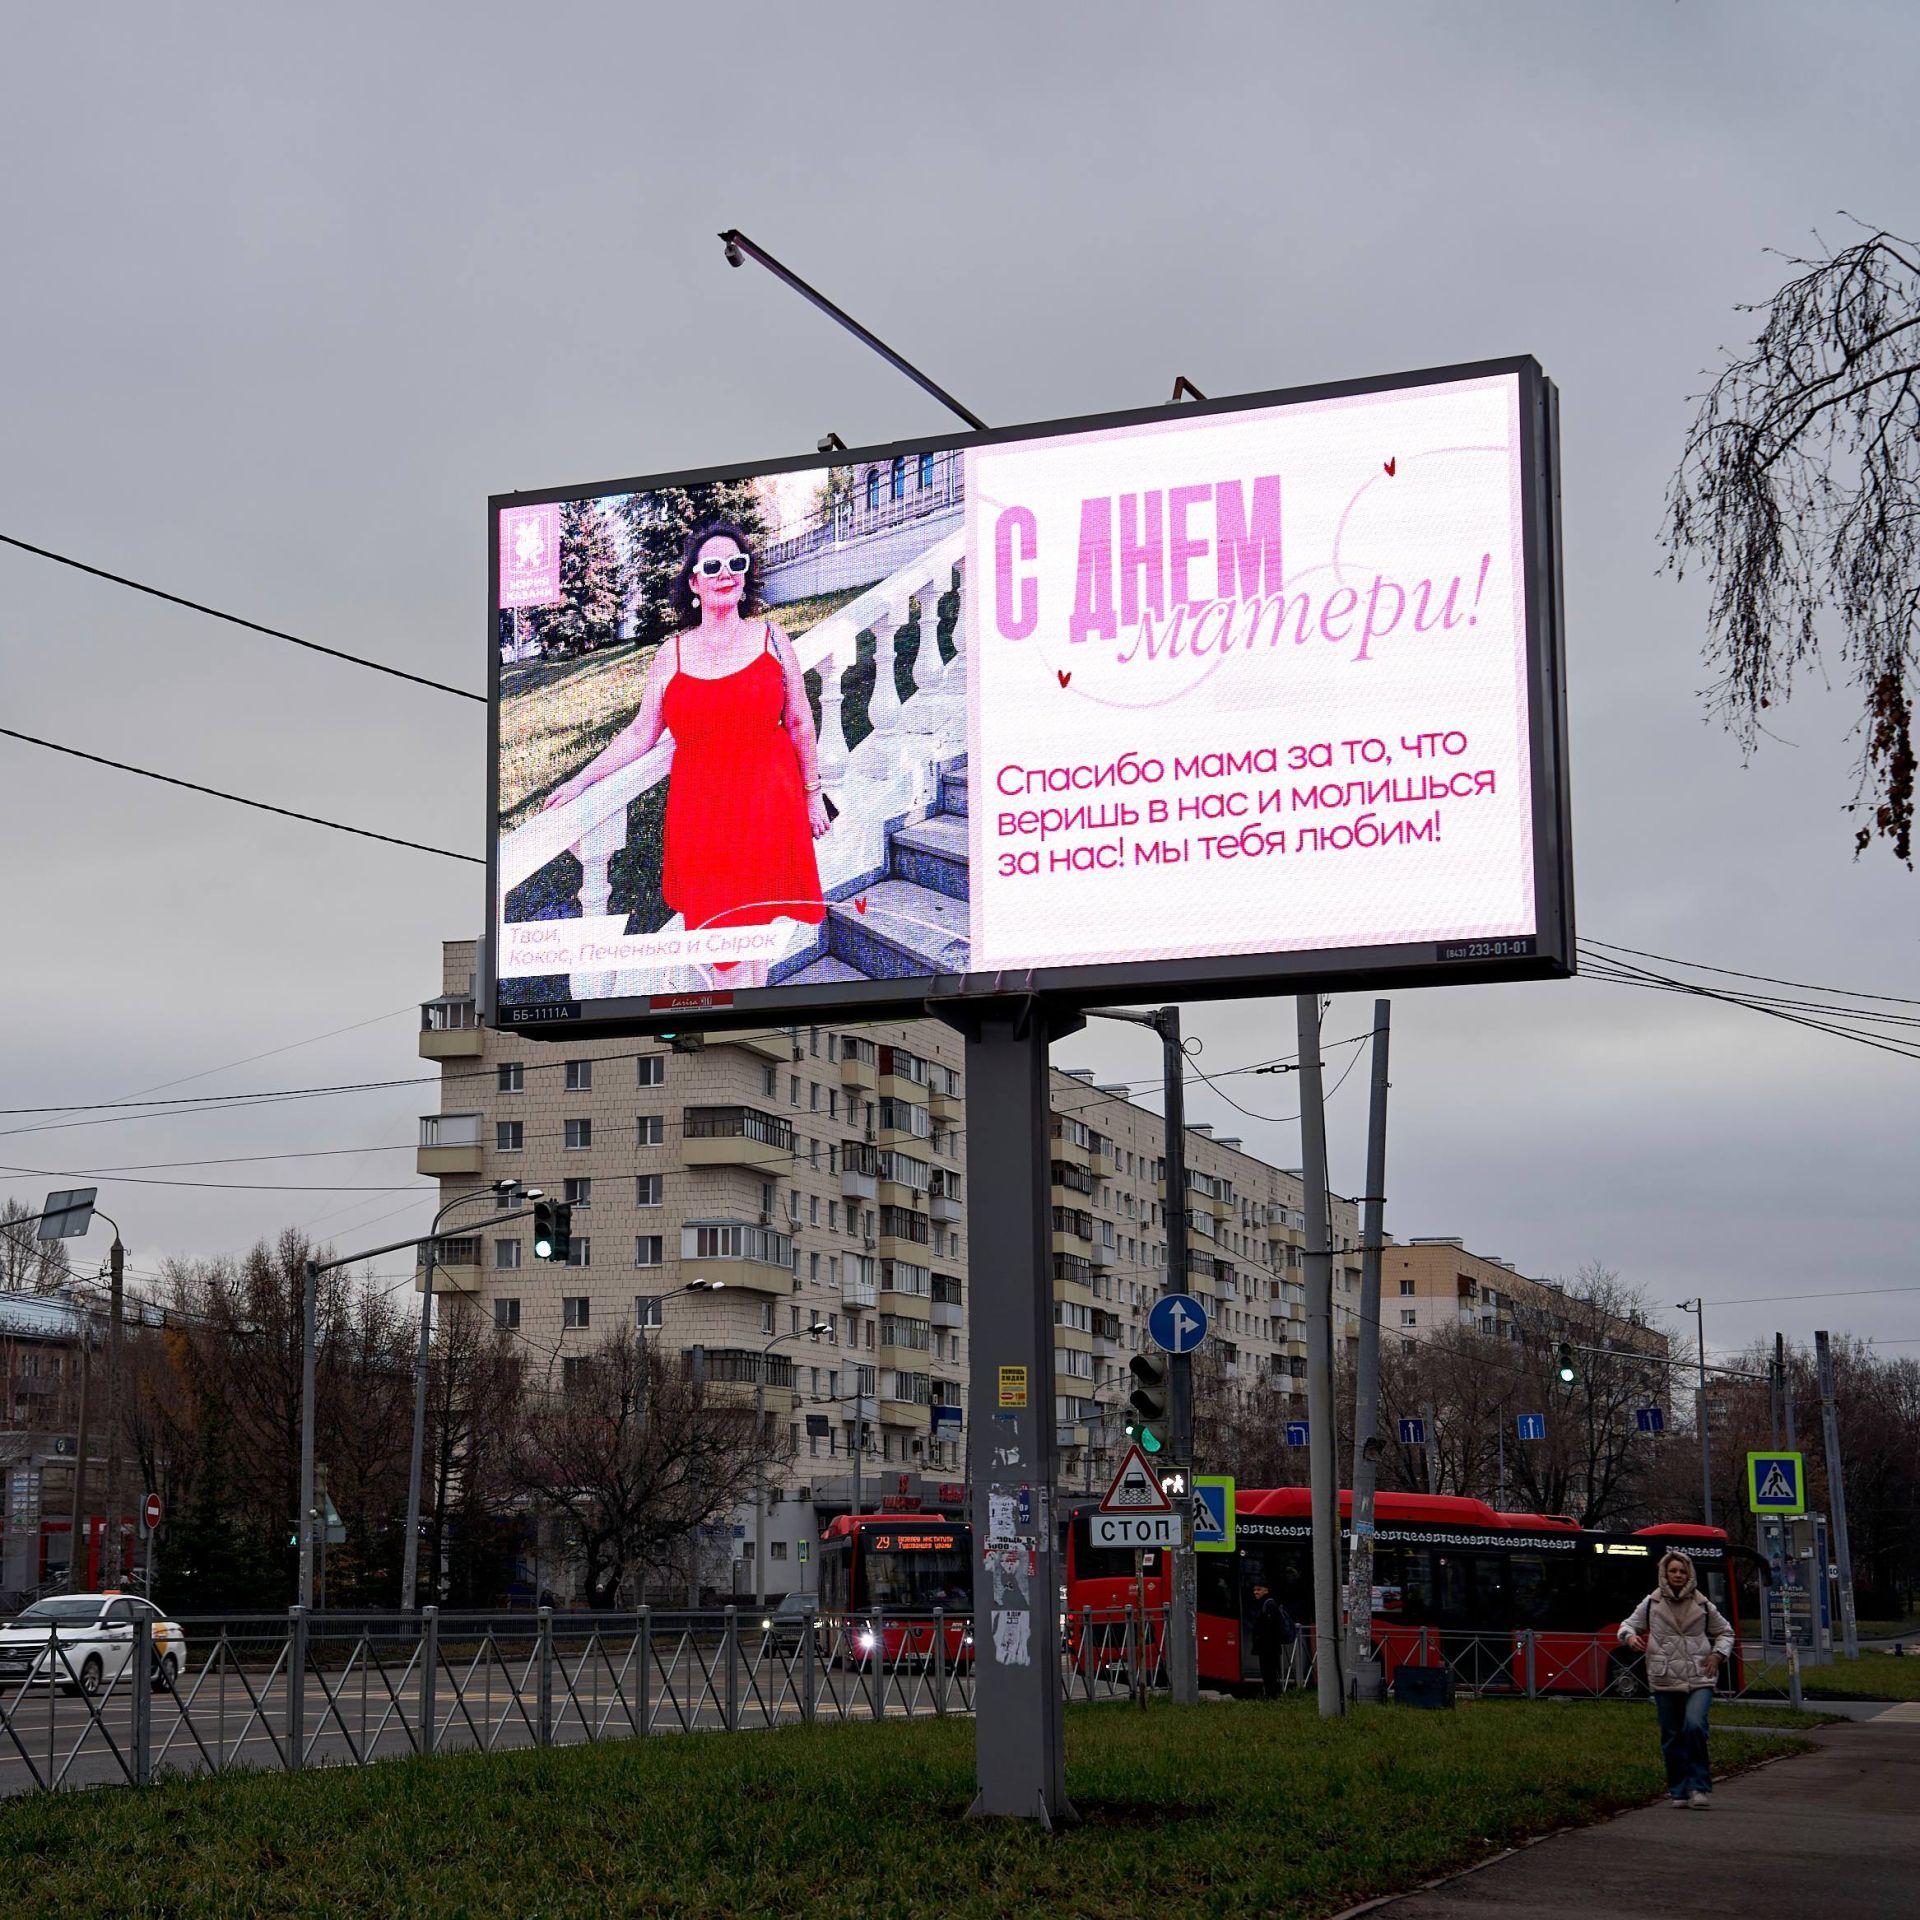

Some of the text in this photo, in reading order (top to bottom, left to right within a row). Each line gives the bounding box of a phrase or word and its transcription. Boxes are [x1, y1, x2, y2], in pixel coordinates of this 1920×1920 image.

[995, 475, 1283, 643] С ДНЕМ
[1117, 553, 1491, 663] матери!
[997, 731, 1467, 796] Спасибо мама за то, что
[998, 770, 1496, 841] веришь в нас и молишься
[999, 811, 1441, 877] за нас! мы тебя любим!
[580, 939, 681, 961] Печенька
[687, 938, 700, 953] и
[706, 933, 777, 954] Сырок
[1468, 941, 1528, 957] 233-01-01
[513, 1007, 569, 1021] ББ-1111А
[876, 1536, 890, 1549] 29
[1101, 1520, 1169, 1542] СТОП
